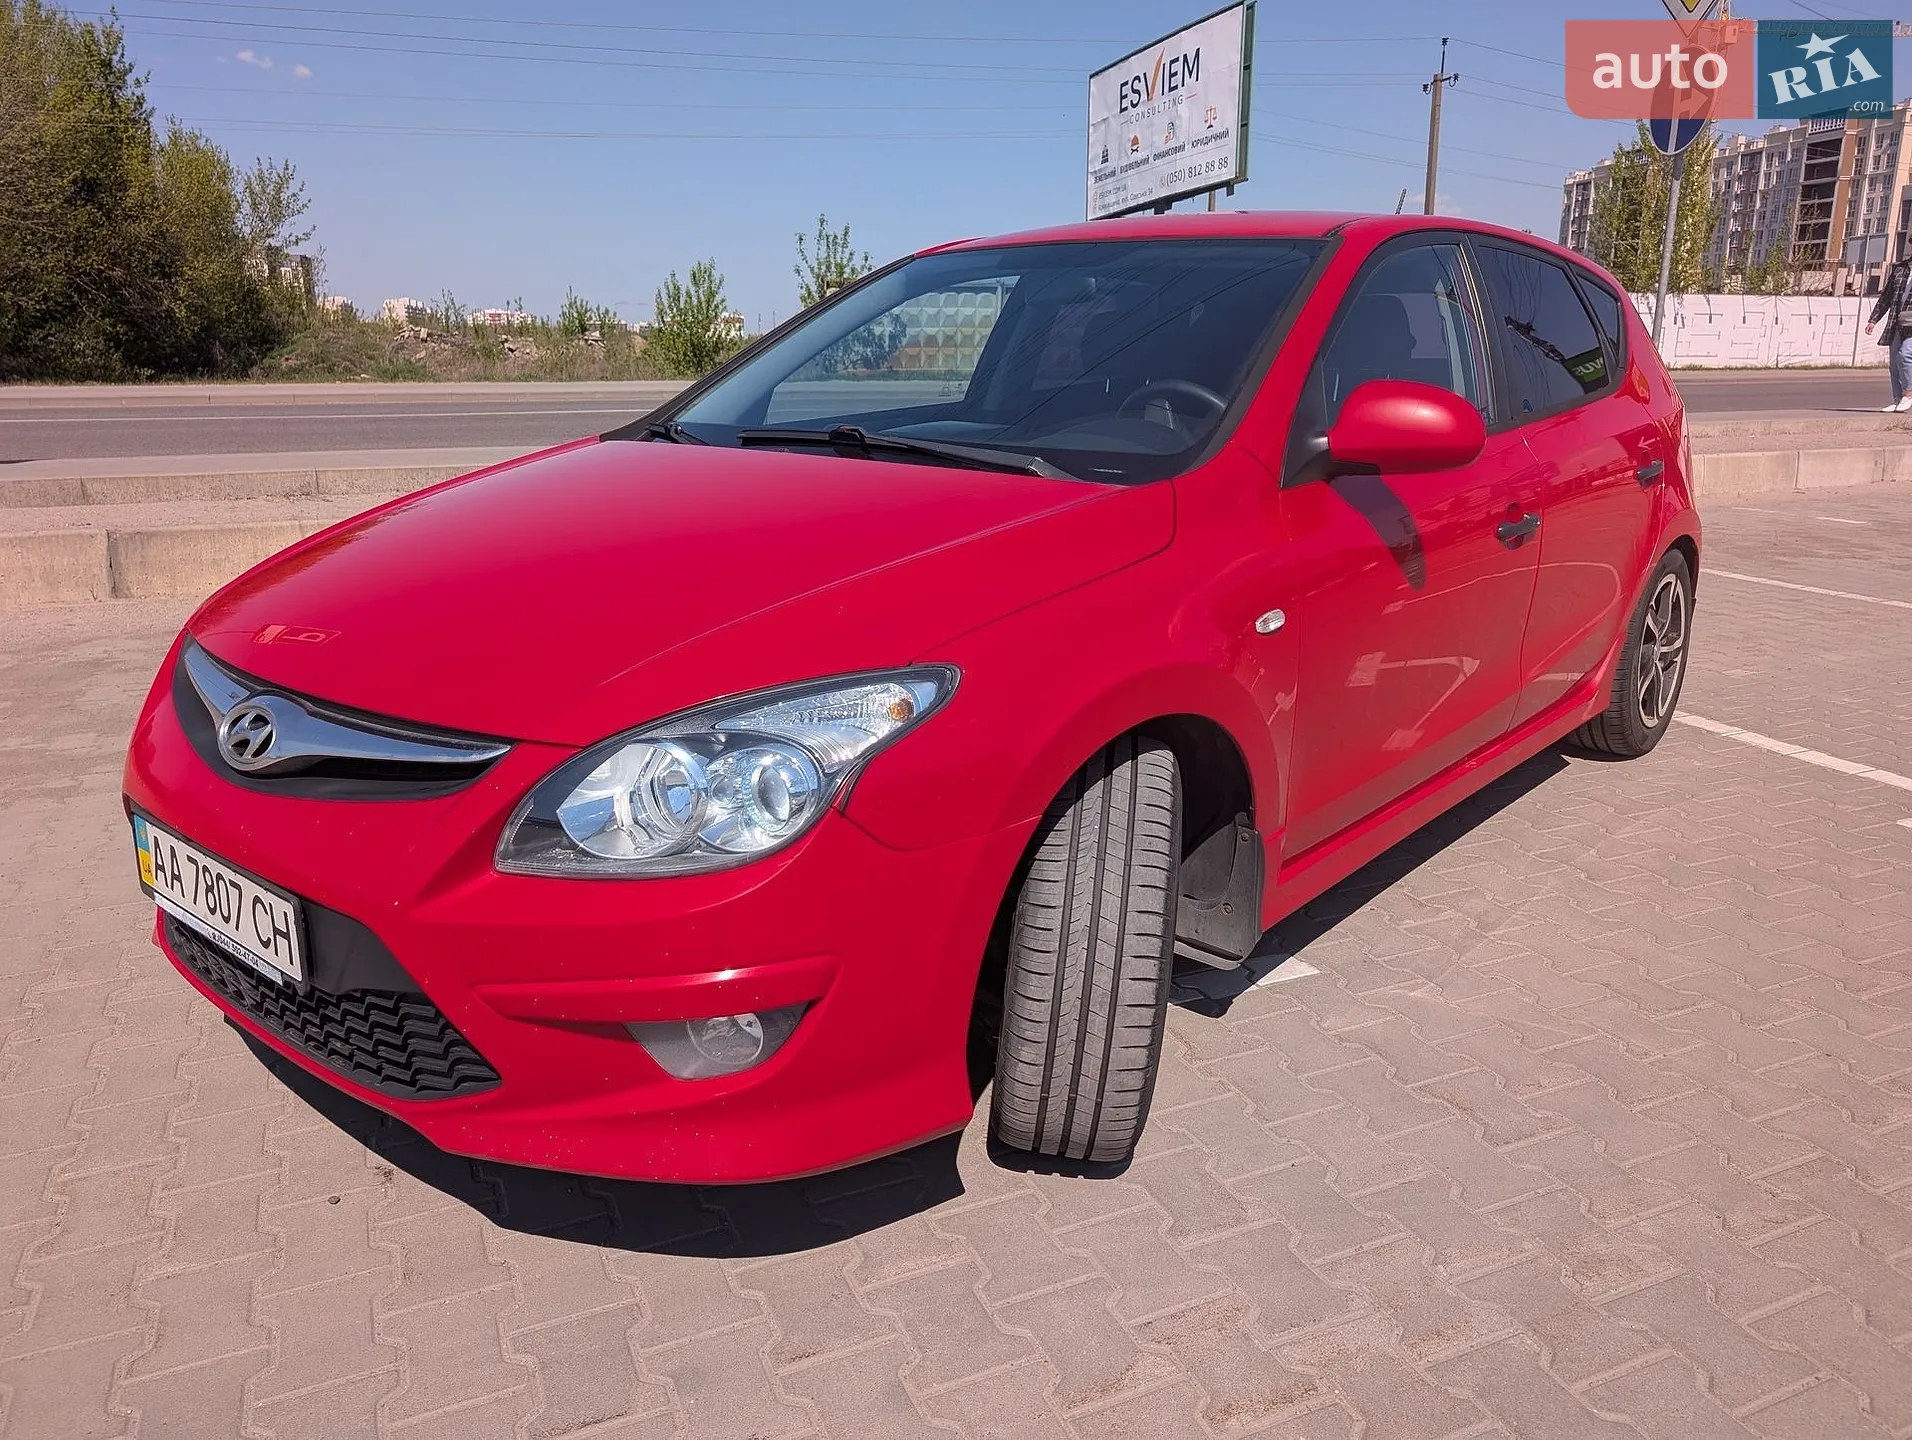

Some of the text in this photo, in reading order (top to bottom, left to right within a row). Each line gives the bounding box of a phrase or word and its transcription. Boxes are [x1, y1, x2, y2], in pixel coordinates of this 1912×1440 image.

[1119, 47, 1200, 113] ESVIEM
[1129, 94, 1184, 125] CONSULTING
[1191, 127, 1230, 149] ЮРИДИЧНИЙ
[1166, 156, 1229, 187] (050) 812 88 88
[153, 835, 295, 966] AA 7807 CH
